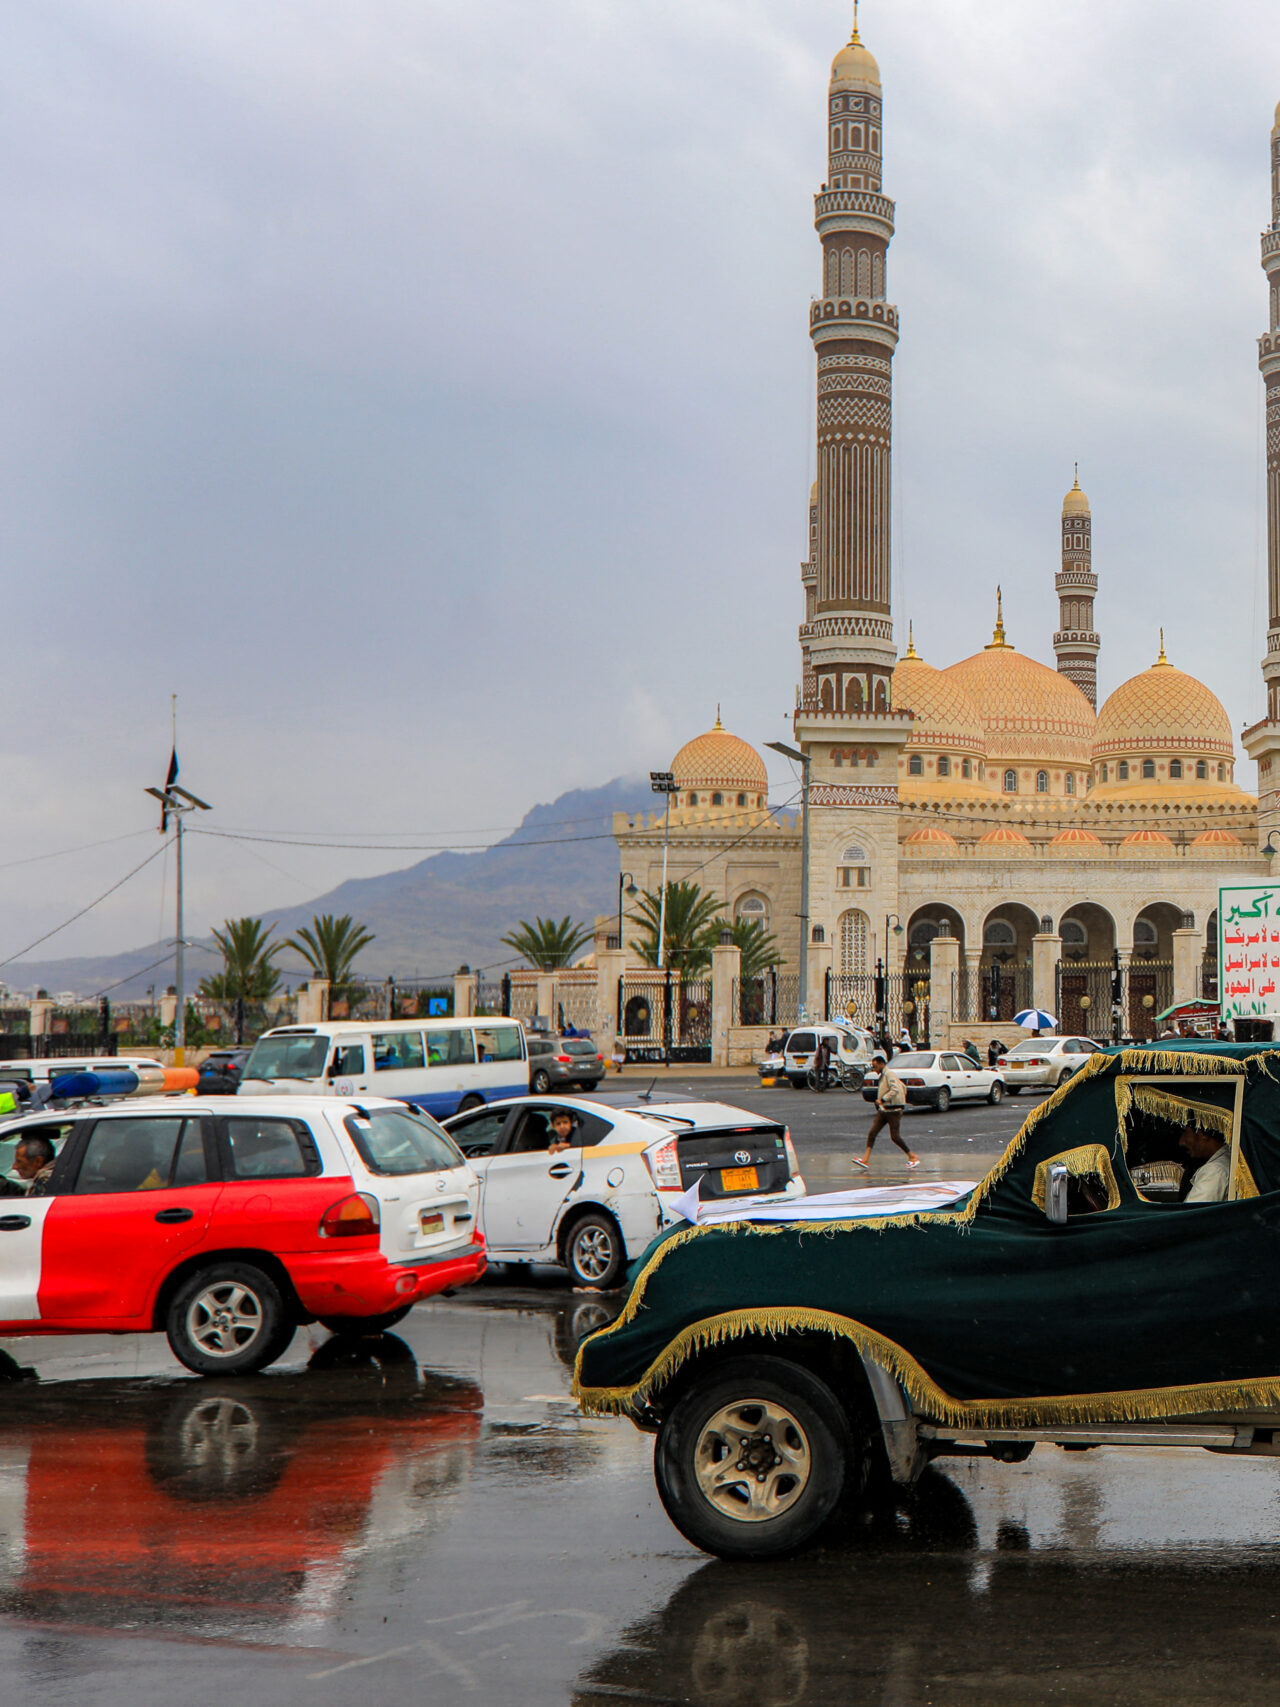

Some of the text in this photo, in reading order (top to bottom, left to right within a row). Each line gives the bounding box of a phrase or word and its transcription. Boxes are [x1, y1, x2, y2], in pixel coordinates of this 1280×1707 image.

[1224, 890, 1274, 926] أكبر
[1224, 977, 1255, 998] اليهود
[1258, 977, 1276, 997] على
